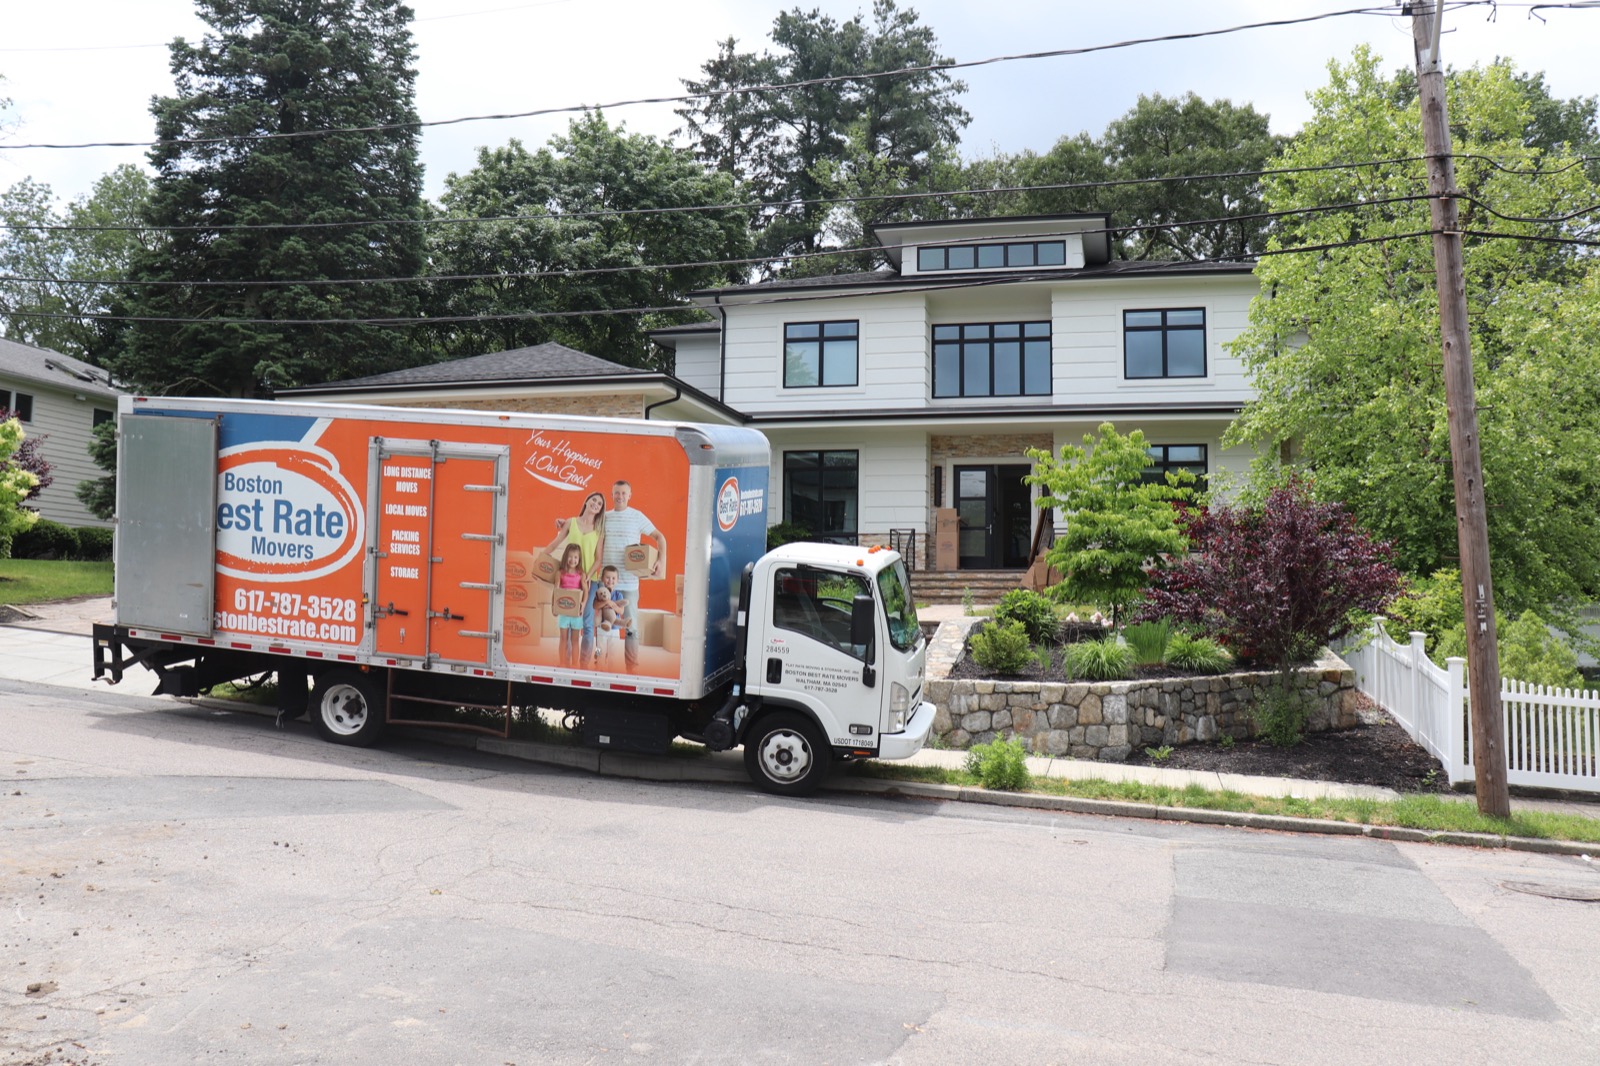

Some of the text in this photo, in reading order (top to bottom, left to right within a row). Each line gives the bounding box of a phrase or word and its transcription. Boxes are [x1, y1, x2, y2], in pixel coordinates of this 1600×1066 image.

[525, 451, 537, 465] Is
[536, 455, 559, 473] Our
[552, 440, 602, 470] Happiness
[384, 465, 431, 479] LONG DISTANCE
[224, 472, 282, 494] Boston
[396, 481, 418, 493] MOVES
[217, 499, 344, 539] est Rate
[386, 504, 427, 517] LOCAL MOVES
[392, 530, 420, 542] PACKING
[251, 536, 314, 560] Movers
[390, 543, 420, 555] SERVICES
[390, 566, 418, 579] STORAGE
[234, 588, 356, 622] 617-787-3528
[214, 611, 356, 642] stonbestrate.com
[766, 645, 790, 654] 284559
